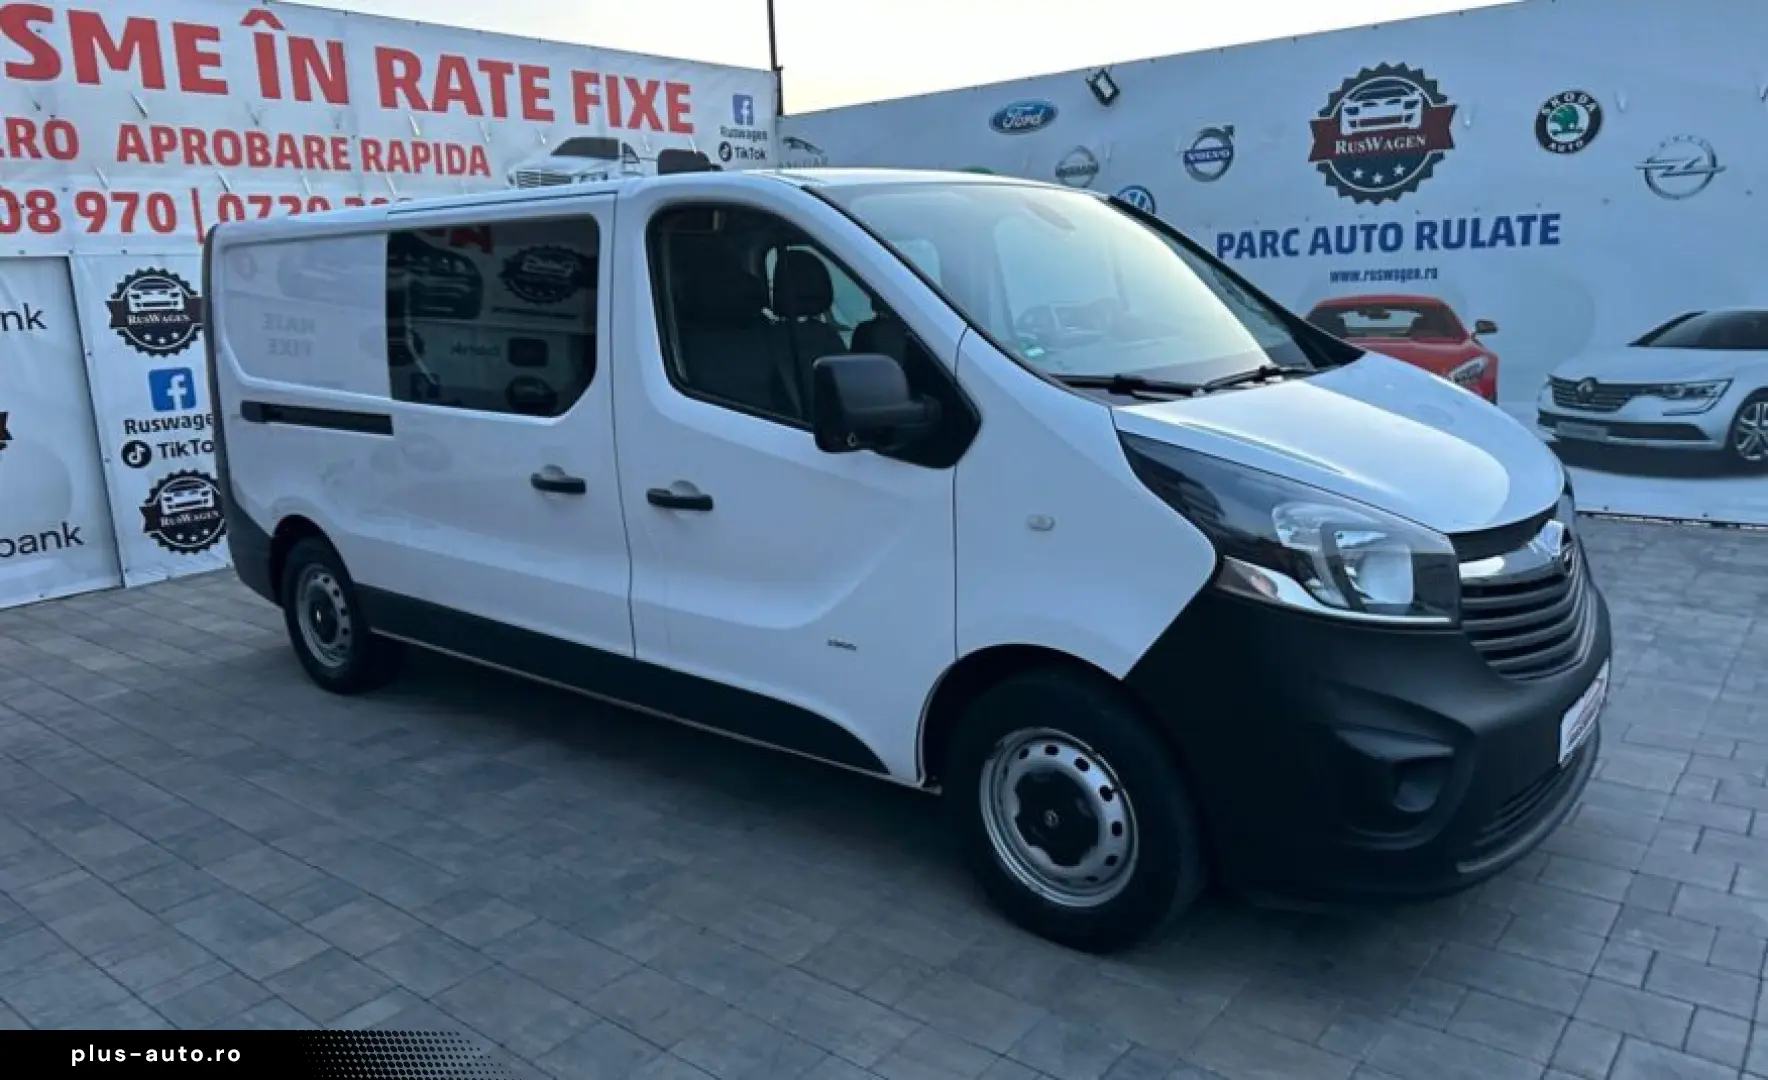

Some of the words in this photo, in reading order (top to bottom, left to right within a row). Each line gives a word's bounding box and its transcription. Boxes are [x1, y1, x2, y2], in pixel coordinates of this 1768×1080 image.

[0, 2, 229, 96] SME
[239, 8, 350, 105] ÎN
[374, 46, 555, 122] RATE
[570, 69, 694, 133] FIXE
[117, 123, 352, 171] APROBARE
[360, 138, 491, 177] RAPIDA
[734, 146, 767, 161] TikTok
[75, 191, 177, 234] 970
[1217, 229, 1300, 259] PARC
[1308, 222, 1404, 256] AUTO
[1415, 213, 1561, 251] RULATE
[124, 413, 213, 435] Ruswage
[157, 438, 214, 459] TikTo
